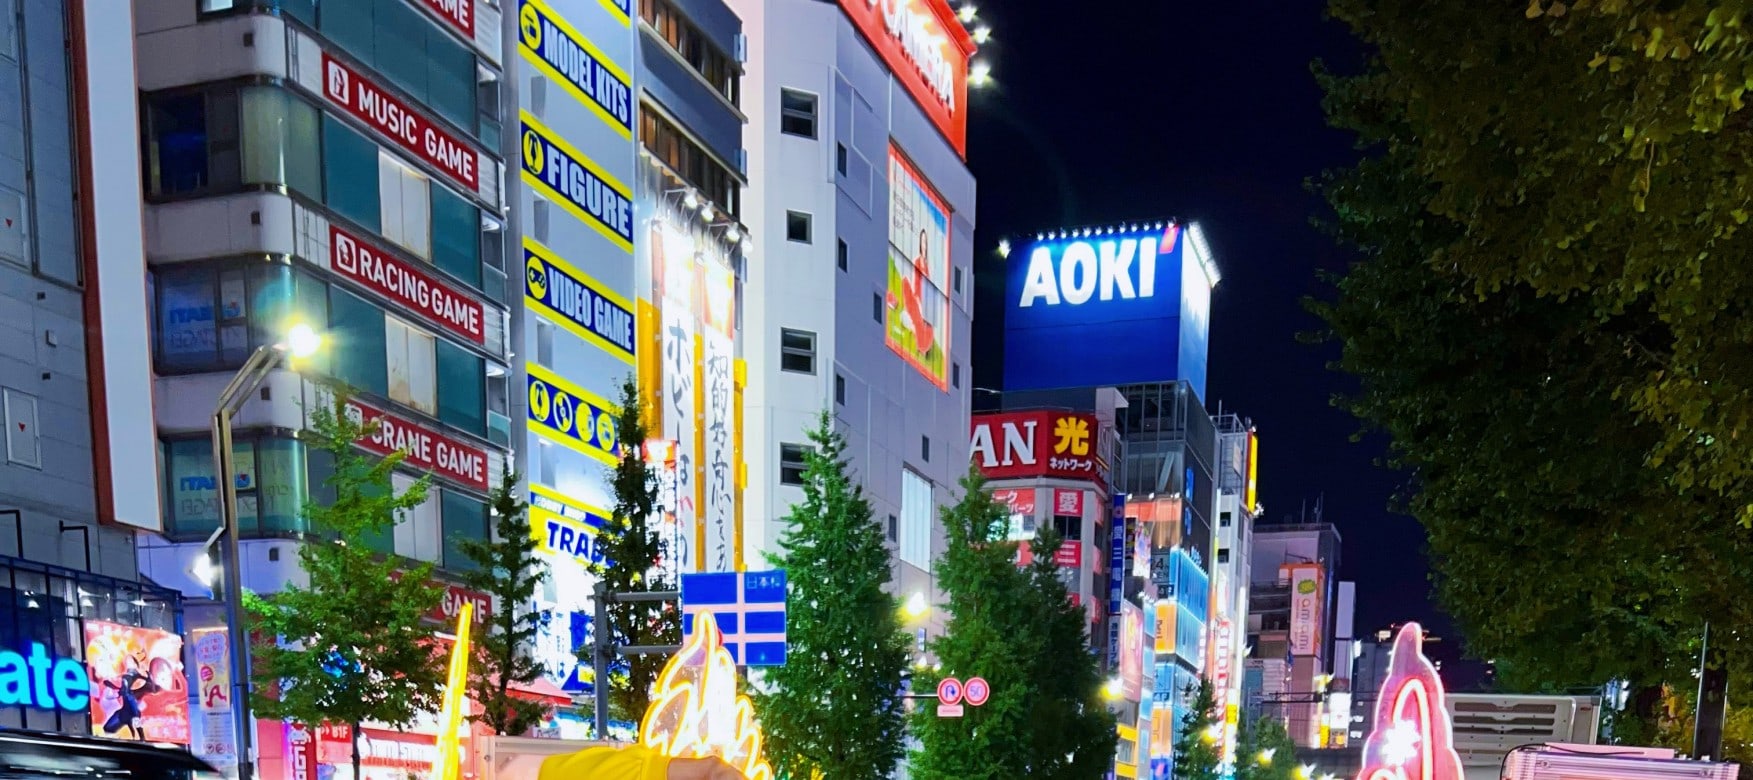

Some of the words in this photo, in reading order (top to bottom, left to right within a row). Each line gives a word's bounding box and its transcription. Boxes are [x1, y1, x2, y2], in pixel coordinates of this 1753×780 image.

[543, 19, 594, 97] MODEL
[596, 62, 628, 124] KITS
[357, 82, 418, 144] MUSIC
[425, 127, 474, 181] GAME
[546, 144, 630, 238] FIGURE
[360, 247, 430, 308] RACING
[431, 288, 480, 335] GAME
[1019, 236, 1157, 308] AOKI
[548, 266, 592, 327] VIDEO
[594, 295, 632, 350] GAME
[371, 416, 432, 463] CRANE
[436, 442, 483, 483] GAME
[969, 420, 1037, 468] AN
[1049, 457, 1092, 472] ネットワーク
[1053, 416, 1090, 456] 光
[0, 640, 91, 711] ate
[969, 685, 983, 697] 50
